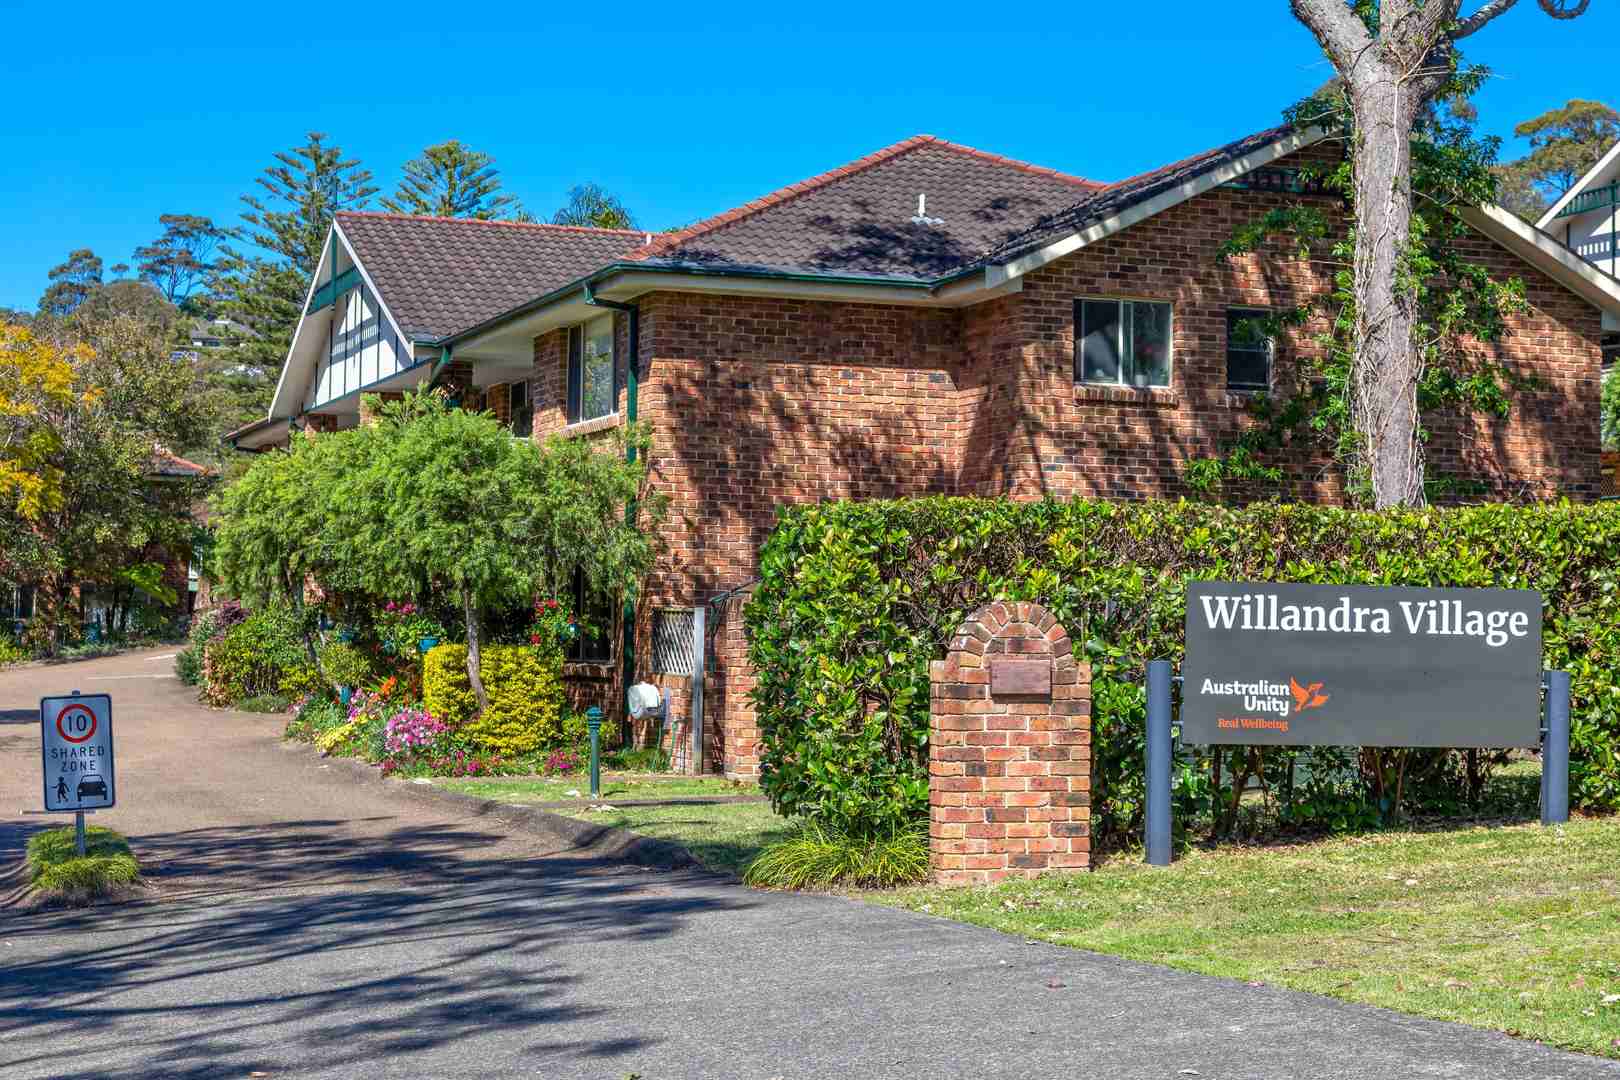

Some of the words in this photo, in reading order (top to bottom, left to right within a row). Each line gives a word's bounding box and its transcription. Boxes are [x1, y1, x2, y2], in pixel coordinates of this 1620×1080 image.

[1199, 594, 1391, 634] Willandra
[1399, 600, 1529, 647] Village
[1200, 678, 1290, 697] Australian
[1244, 696, 1289, 717] Unity
[67, 714, 87, 732] 10
[1218, 717, 1239, 729] Real
[1240, 717, 1289, 732] Wellbeing
[50, 745, 105, 760] SHARED
[61, 759, 97, 773] ZONE
